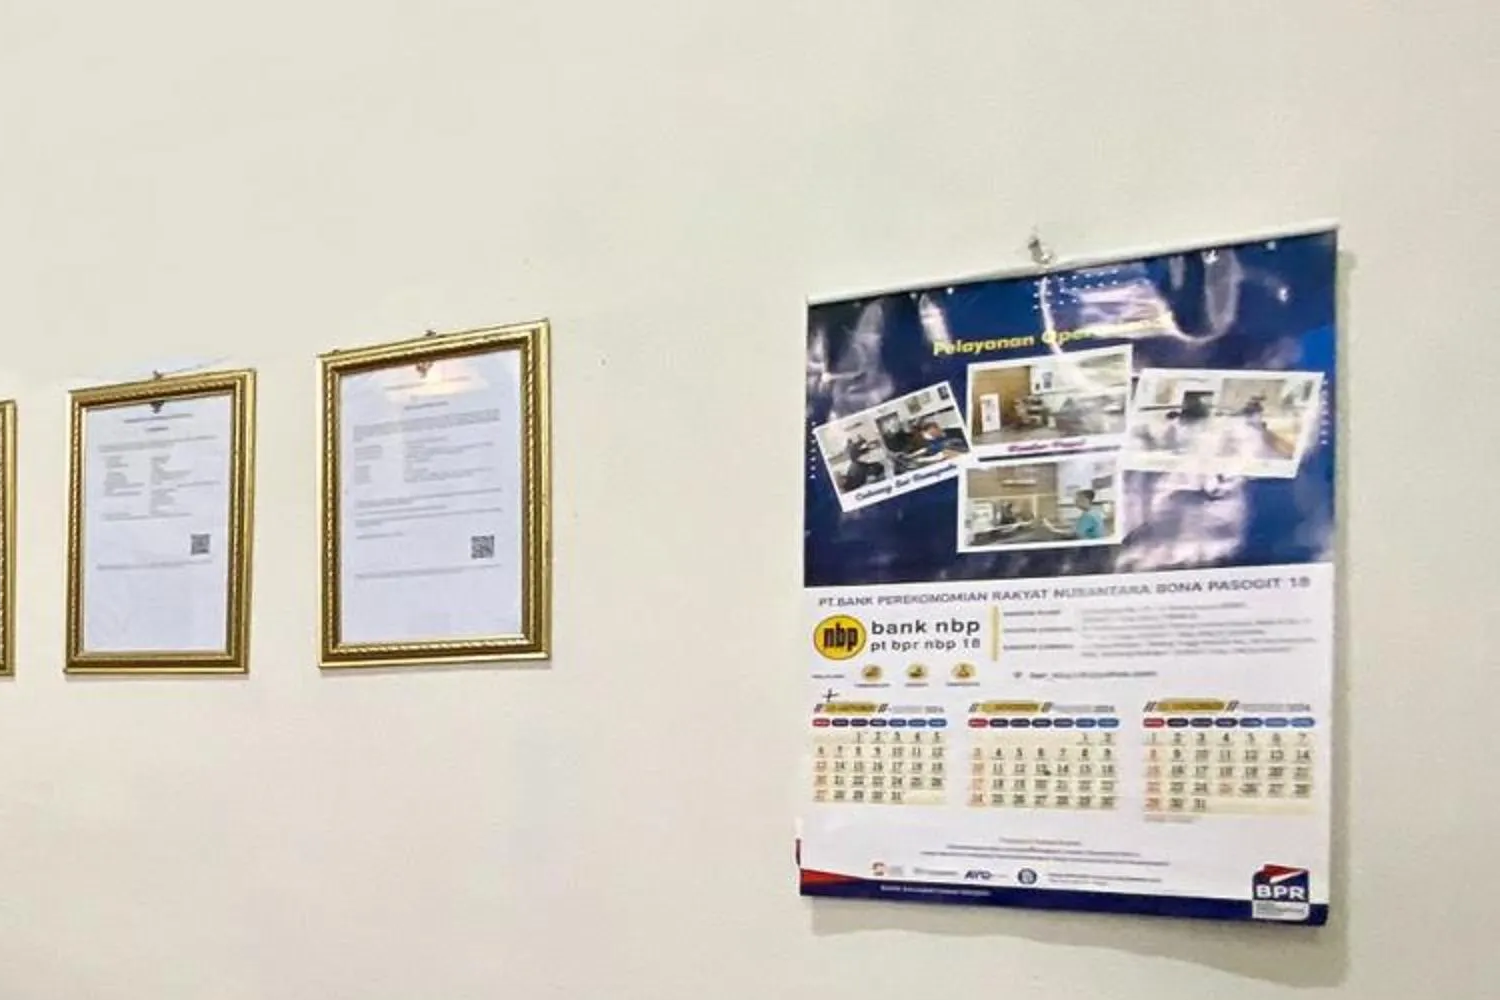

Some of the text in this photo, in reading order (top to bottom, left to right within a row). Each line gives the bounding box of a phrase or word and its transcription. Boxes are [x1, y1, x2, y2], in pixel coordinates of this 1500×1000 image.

[933, 334, 1035, 356] Pelayanan
[992, 588, 1048, 601] RAKYAT
[1156, 580, 1203, 595] BONA
[1208, 577, 1281, 592] PASOGIT
[823, 622, 859, 649] nbp
[871, 617, 981, 636] bank nbp
[871, 639, 888, 652] pt
[891, 638, 919, 652] bpr
[924, 637, 956, 651] nbp
[1255, 885, 1306, 900] BPR
